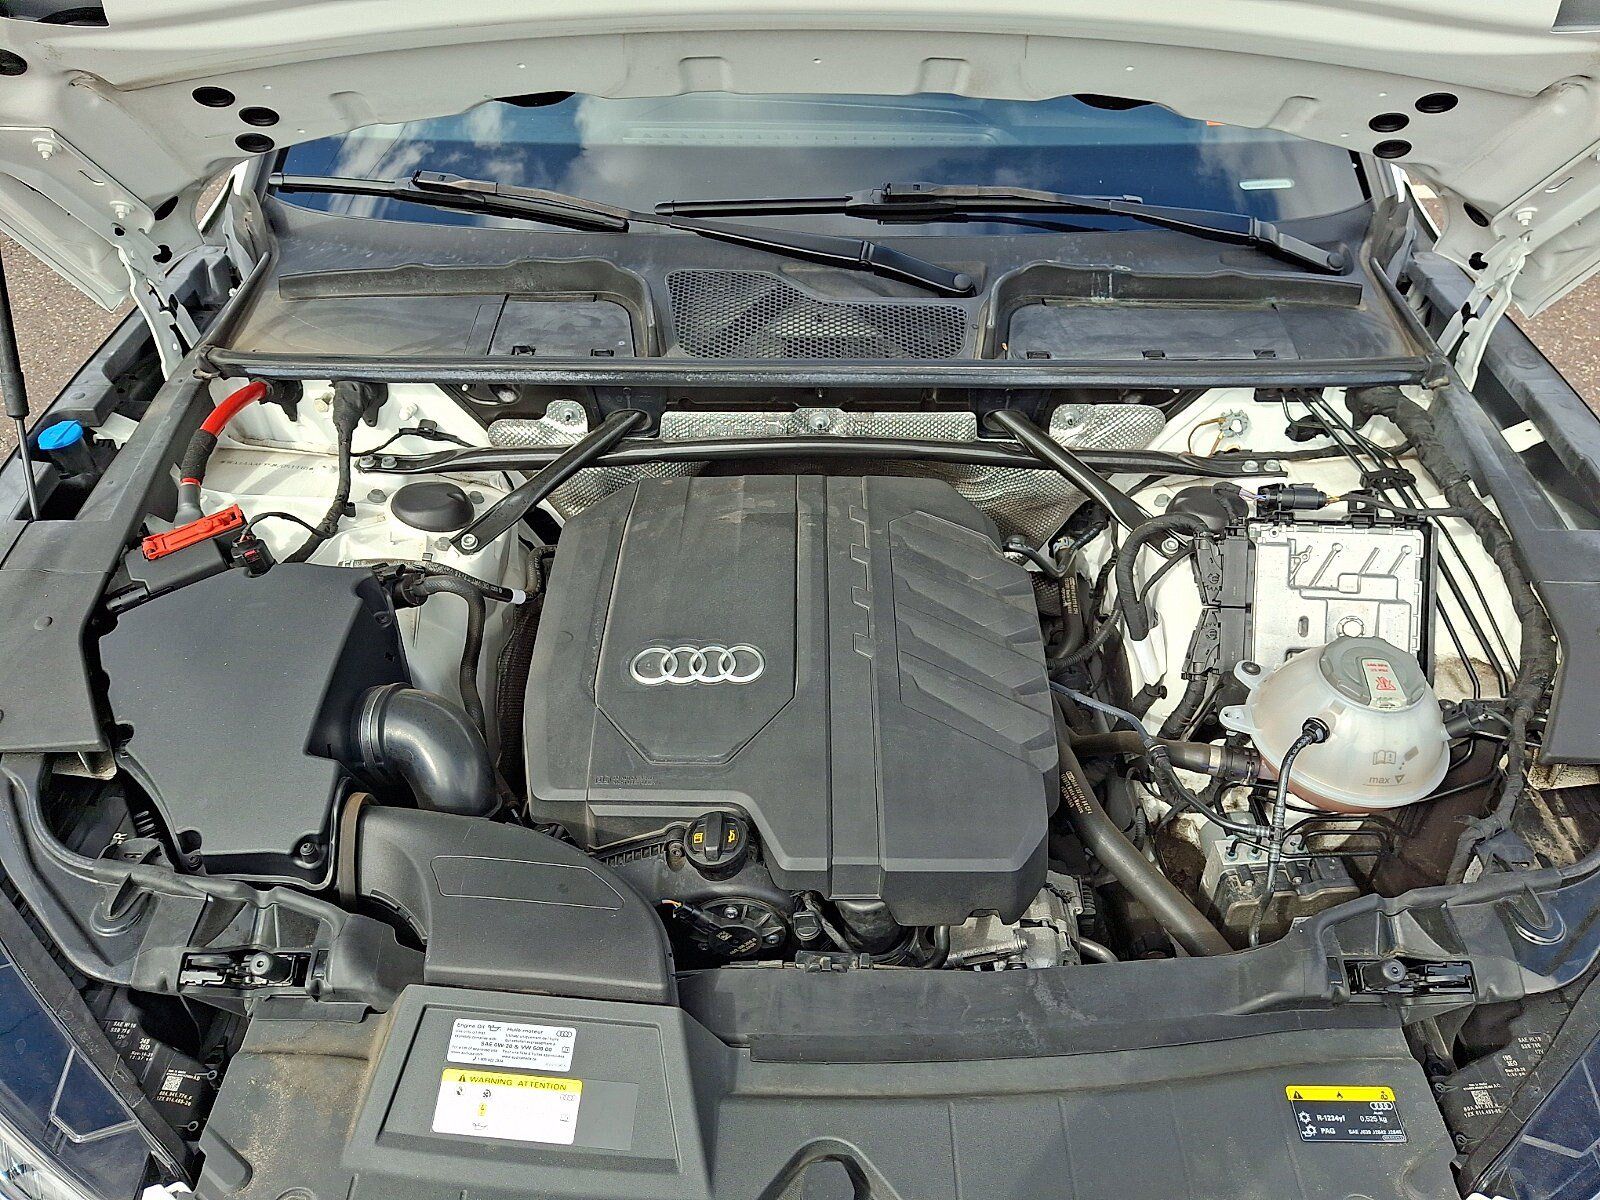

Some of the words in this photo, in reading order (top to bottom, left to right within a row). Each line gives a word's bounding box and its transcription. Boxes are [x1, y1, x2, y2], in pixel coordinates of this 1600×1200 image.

[1368, 776, 1390, 784] max
[456, 1022, 476, 1030] Engine
[470, 1076, 513, 1087] WARNING
[517, 1080, 567, 1091] ATTENTION
[1379, 1115, 1388, 1123] kg
[1320, 1127, 1336, 1135] PAG
